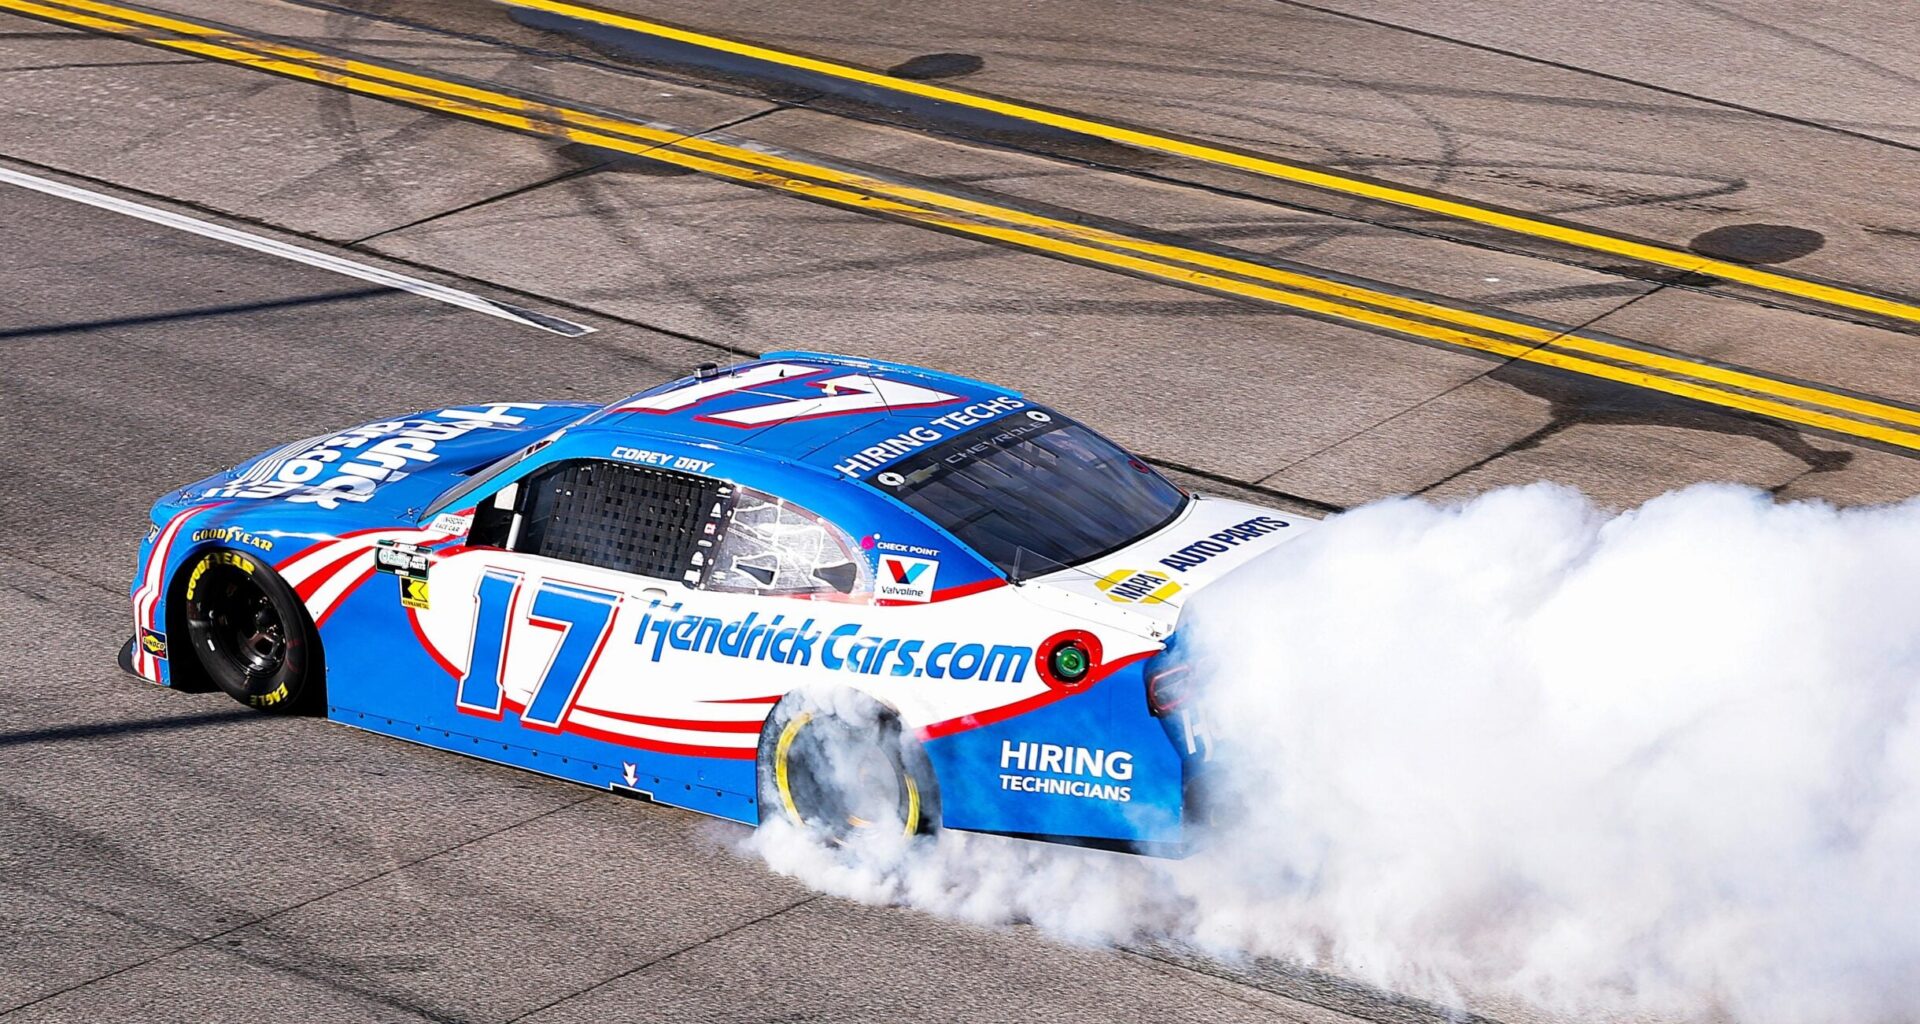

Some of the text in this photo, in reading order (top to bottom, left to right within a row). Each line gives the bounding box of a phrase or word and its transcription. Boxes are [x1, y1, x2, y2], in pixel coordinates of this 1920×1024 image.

[610, 361, 968, 429] 17
[834, 396, 1025, 479] HIRING TECHS
[945, 421, 1053, 465] CHEVROLE
[611, 446, 716, 473] COREY DAY
[192, 526, 274, 552] GOODYEAR
[877, 541, 941, 556] CHECK POINT
[1159, 516, 1291, 573] AUTO PARTS
[881, 586, 924, 597] Valvoline
[1110, 573, 1167, 600] NAPA
[143, 637, 166, 651] SUNOCO
[457, 565, 624, 733] 17
[250, 682, 289, 706] EAGLE
[1000, 740, 1133, 780] HIRING
[1000, 774, 1131, 802] TECHNICIANS
